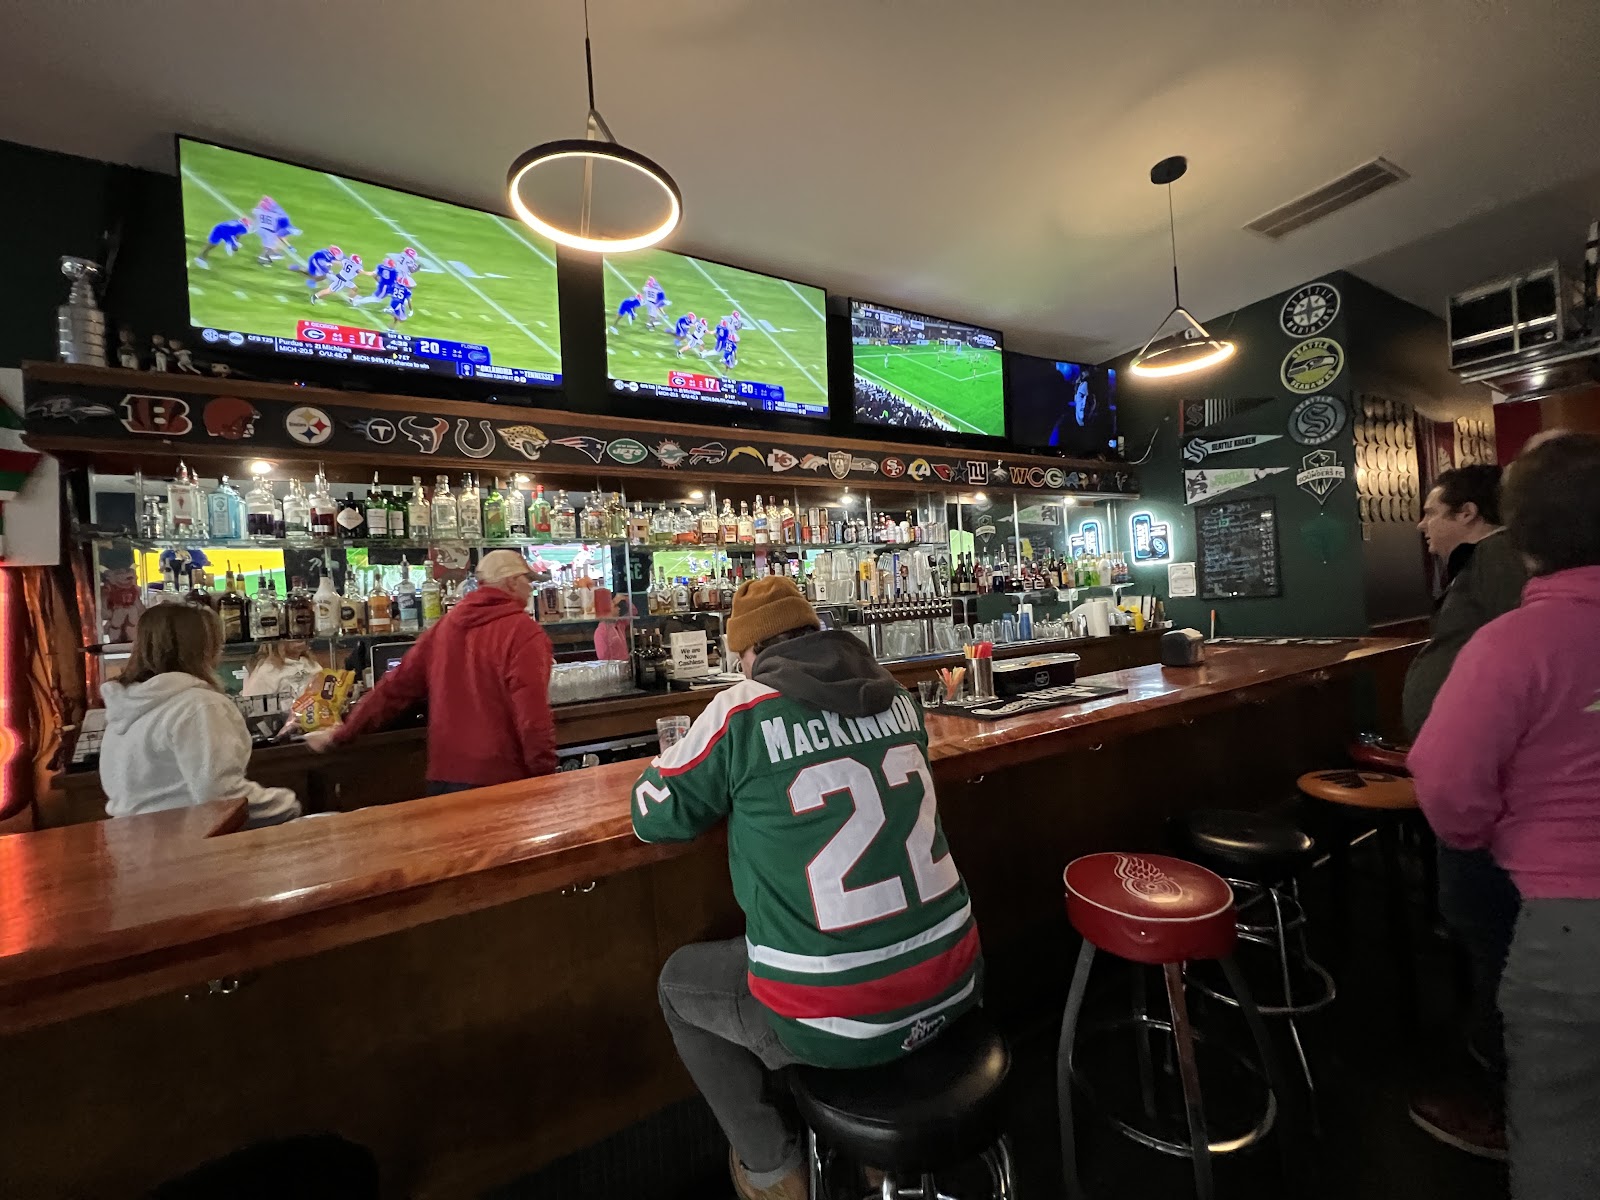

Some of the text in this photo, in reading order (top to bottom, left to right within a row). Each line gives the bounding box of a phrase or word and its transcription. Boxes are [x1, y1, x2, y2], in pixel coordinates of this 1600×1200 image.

[279, 338, 303, 347] Purdue
[322, 344, 352, 354] Michigan
[359, 331, 376, 346] 17
[420, 340, 440, 354] 20
[460, 343, 483, 351] FLORIDA
[1292, 341, 1331, 359] SEATTLE
[279, 345, 297, 353] MICH
[352, 354, 371, 362] MICH:
[394, 359, 413, 367] chance
[704, 377, 716, 390] 17
[1290, 369, 1335, 390] SEAHAWKS
[741, 383, 754, 394] 20
[1211, 441, 1233, 451] SEATTLE
[1233, 436, 1257, 448] KRAKEN
[612, 447, 643, 456] JETS
[886, 459, 902, 476] SF
[1299, 470, 1334, 483] SOUNDERS
[678, 659, 705, 667] Cashless
[787, 743, 961, 933] 22
